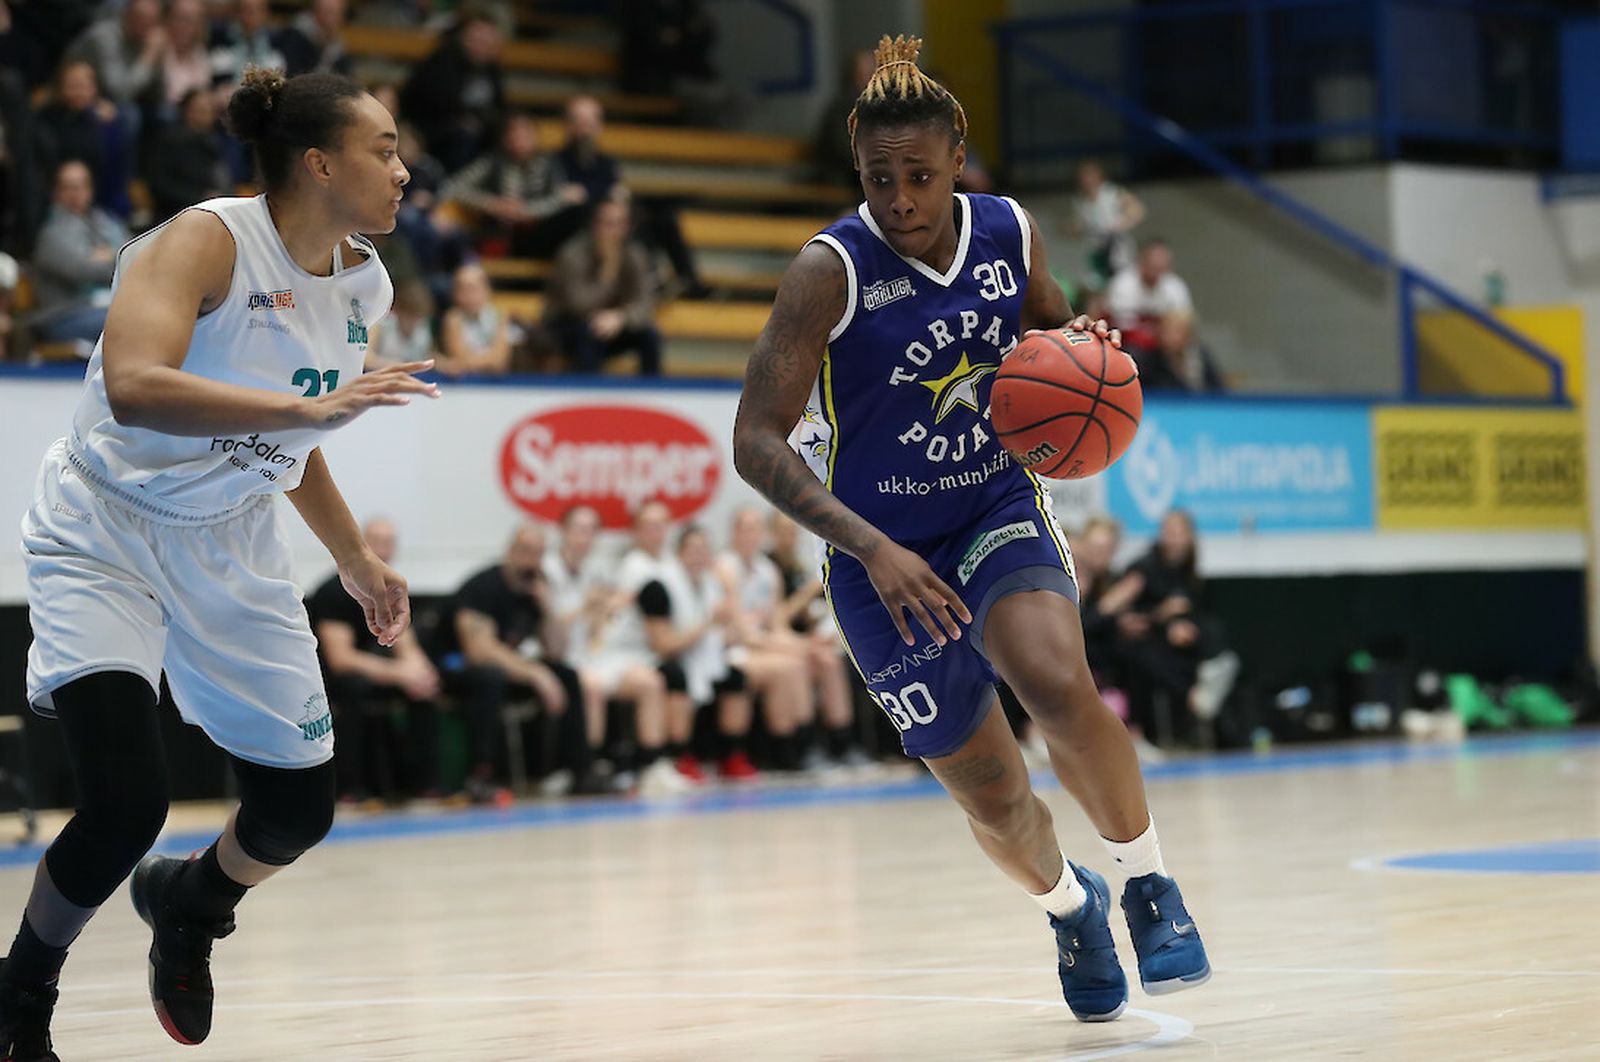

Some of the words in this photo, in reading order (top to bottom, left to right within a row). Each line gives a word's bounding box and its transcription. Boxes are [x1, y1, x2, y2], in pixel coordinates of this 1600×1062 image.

[972, 259, 1018, 301] 30
[291, 367, 340, 397] 21
[511, 421, 713, 515] Semper
[880, 681, 938, 731] 30
